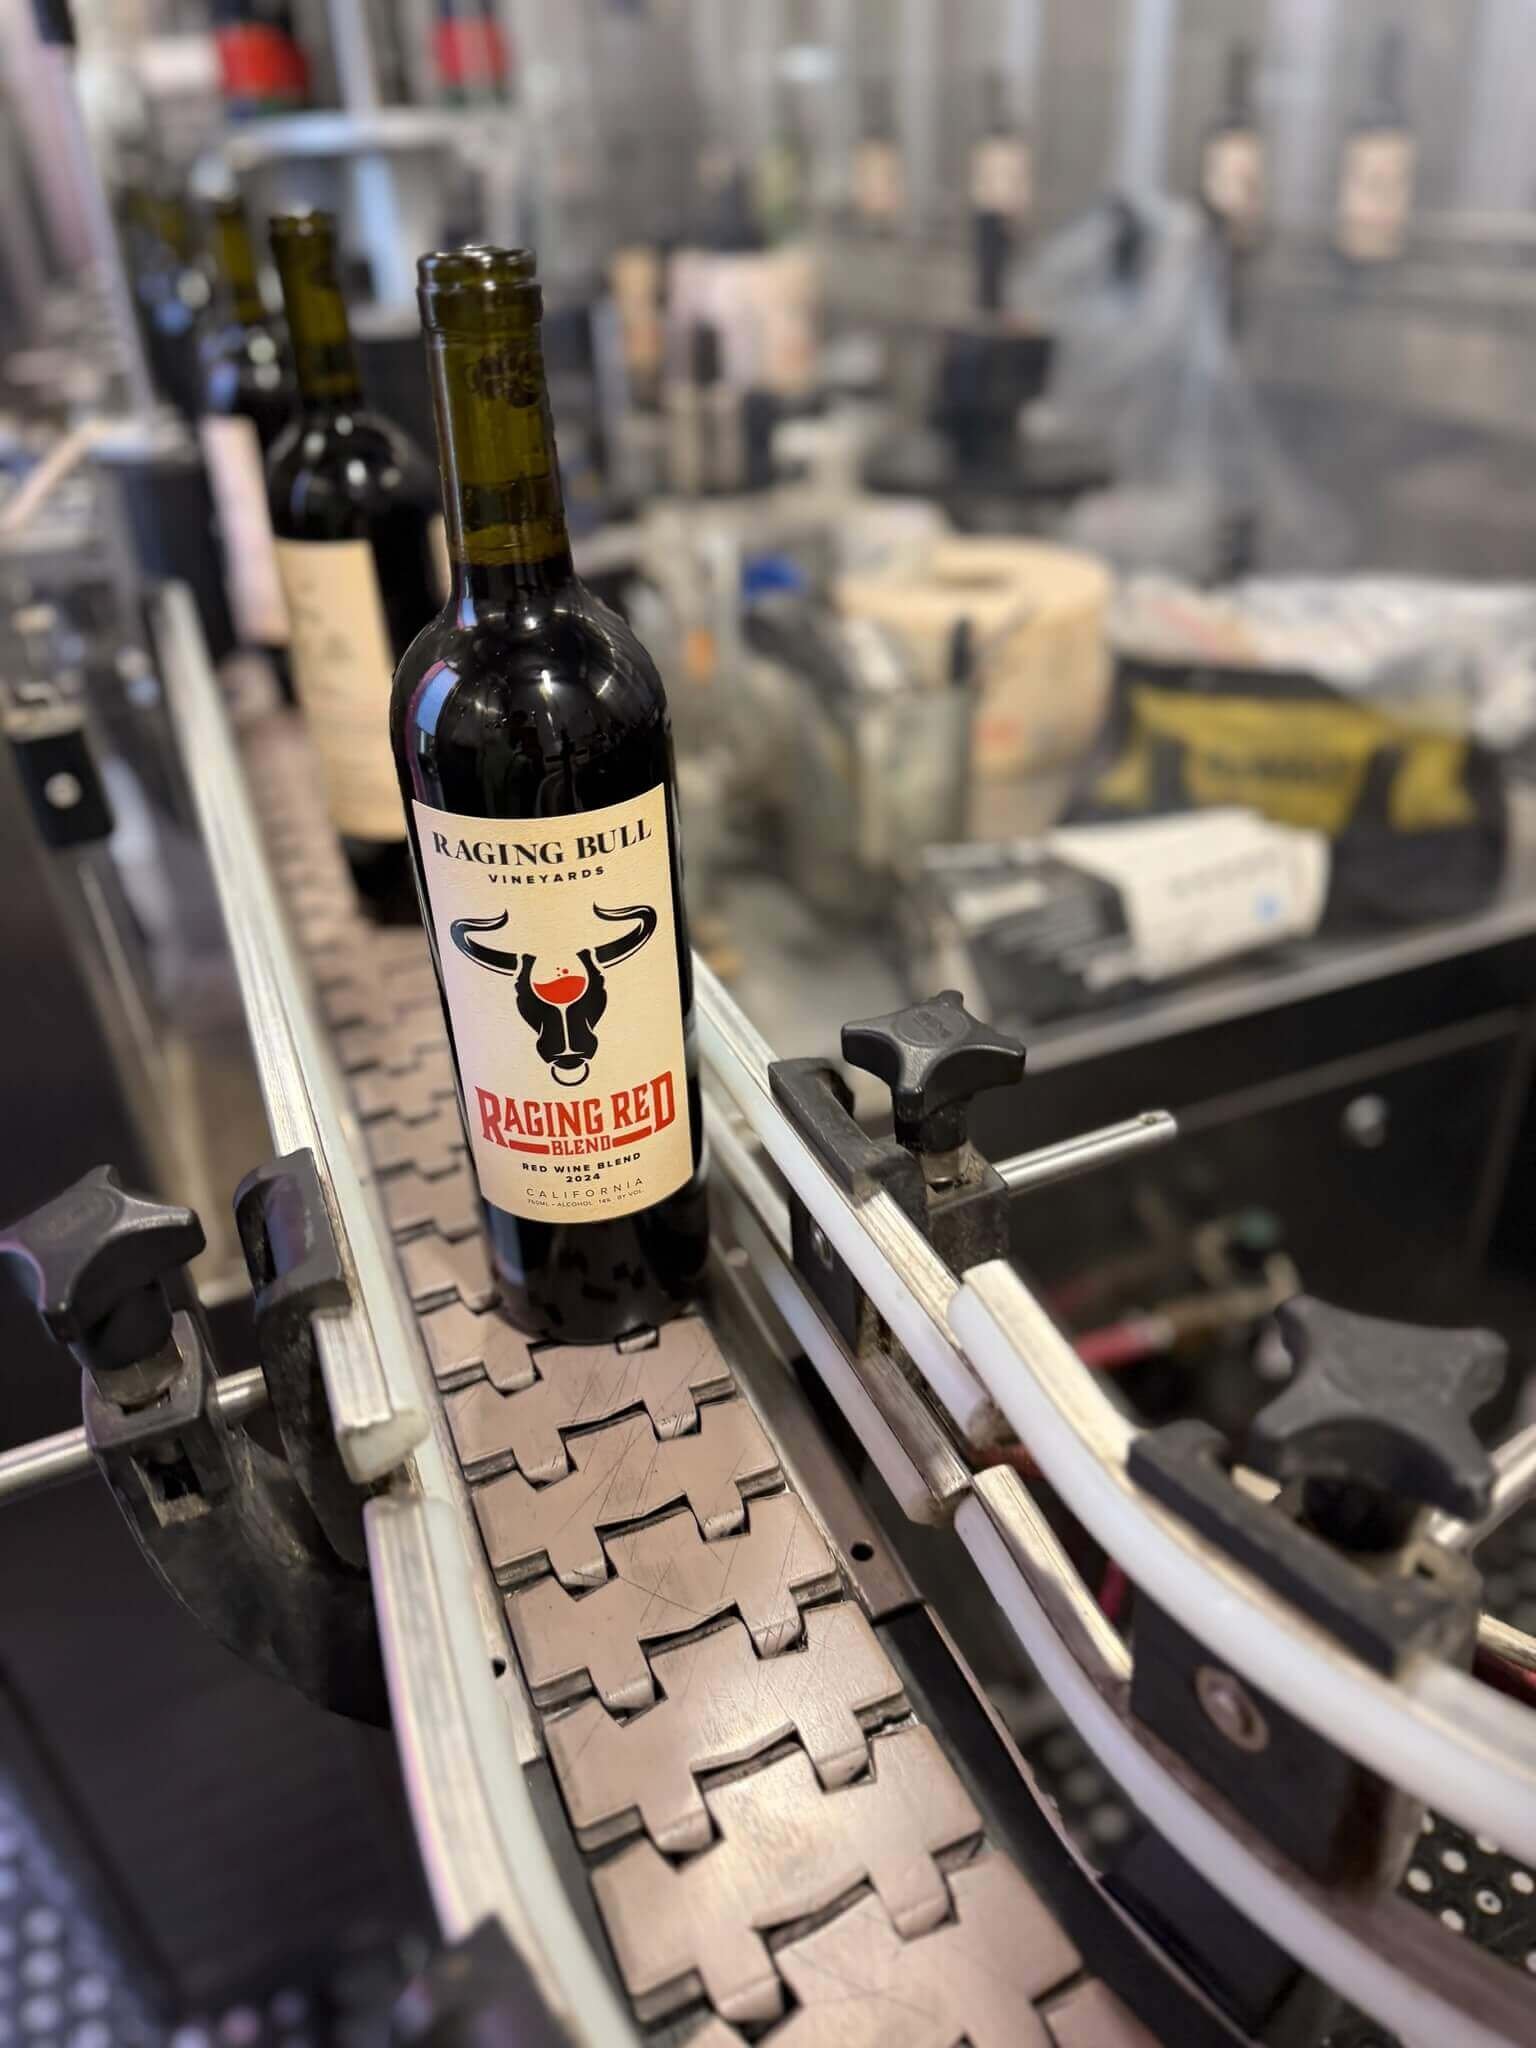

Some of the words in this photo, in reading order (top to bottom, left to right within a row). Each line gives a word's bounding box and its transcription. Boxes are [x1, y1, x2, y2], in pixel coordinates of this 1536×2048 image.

[432, 830, 564, 866] RAGING
[575, 819, 652, 861] BULL
[489, 866, 606, 884] VINEYARDS
[475, 1086, 604, 1148] RAGING
[610, 1070, 676, 1133] RED
[551, 1135, 613, 1156] BLEND
[522, 1162, 548, 1173] RED
[554, 1164, 591, 1173] WINE
[597, 1152, 641, 1170] BLEND
[526, 1177, 643, 1199] CALIFORNIA
[566, 1173, 601, 1183] 2024
